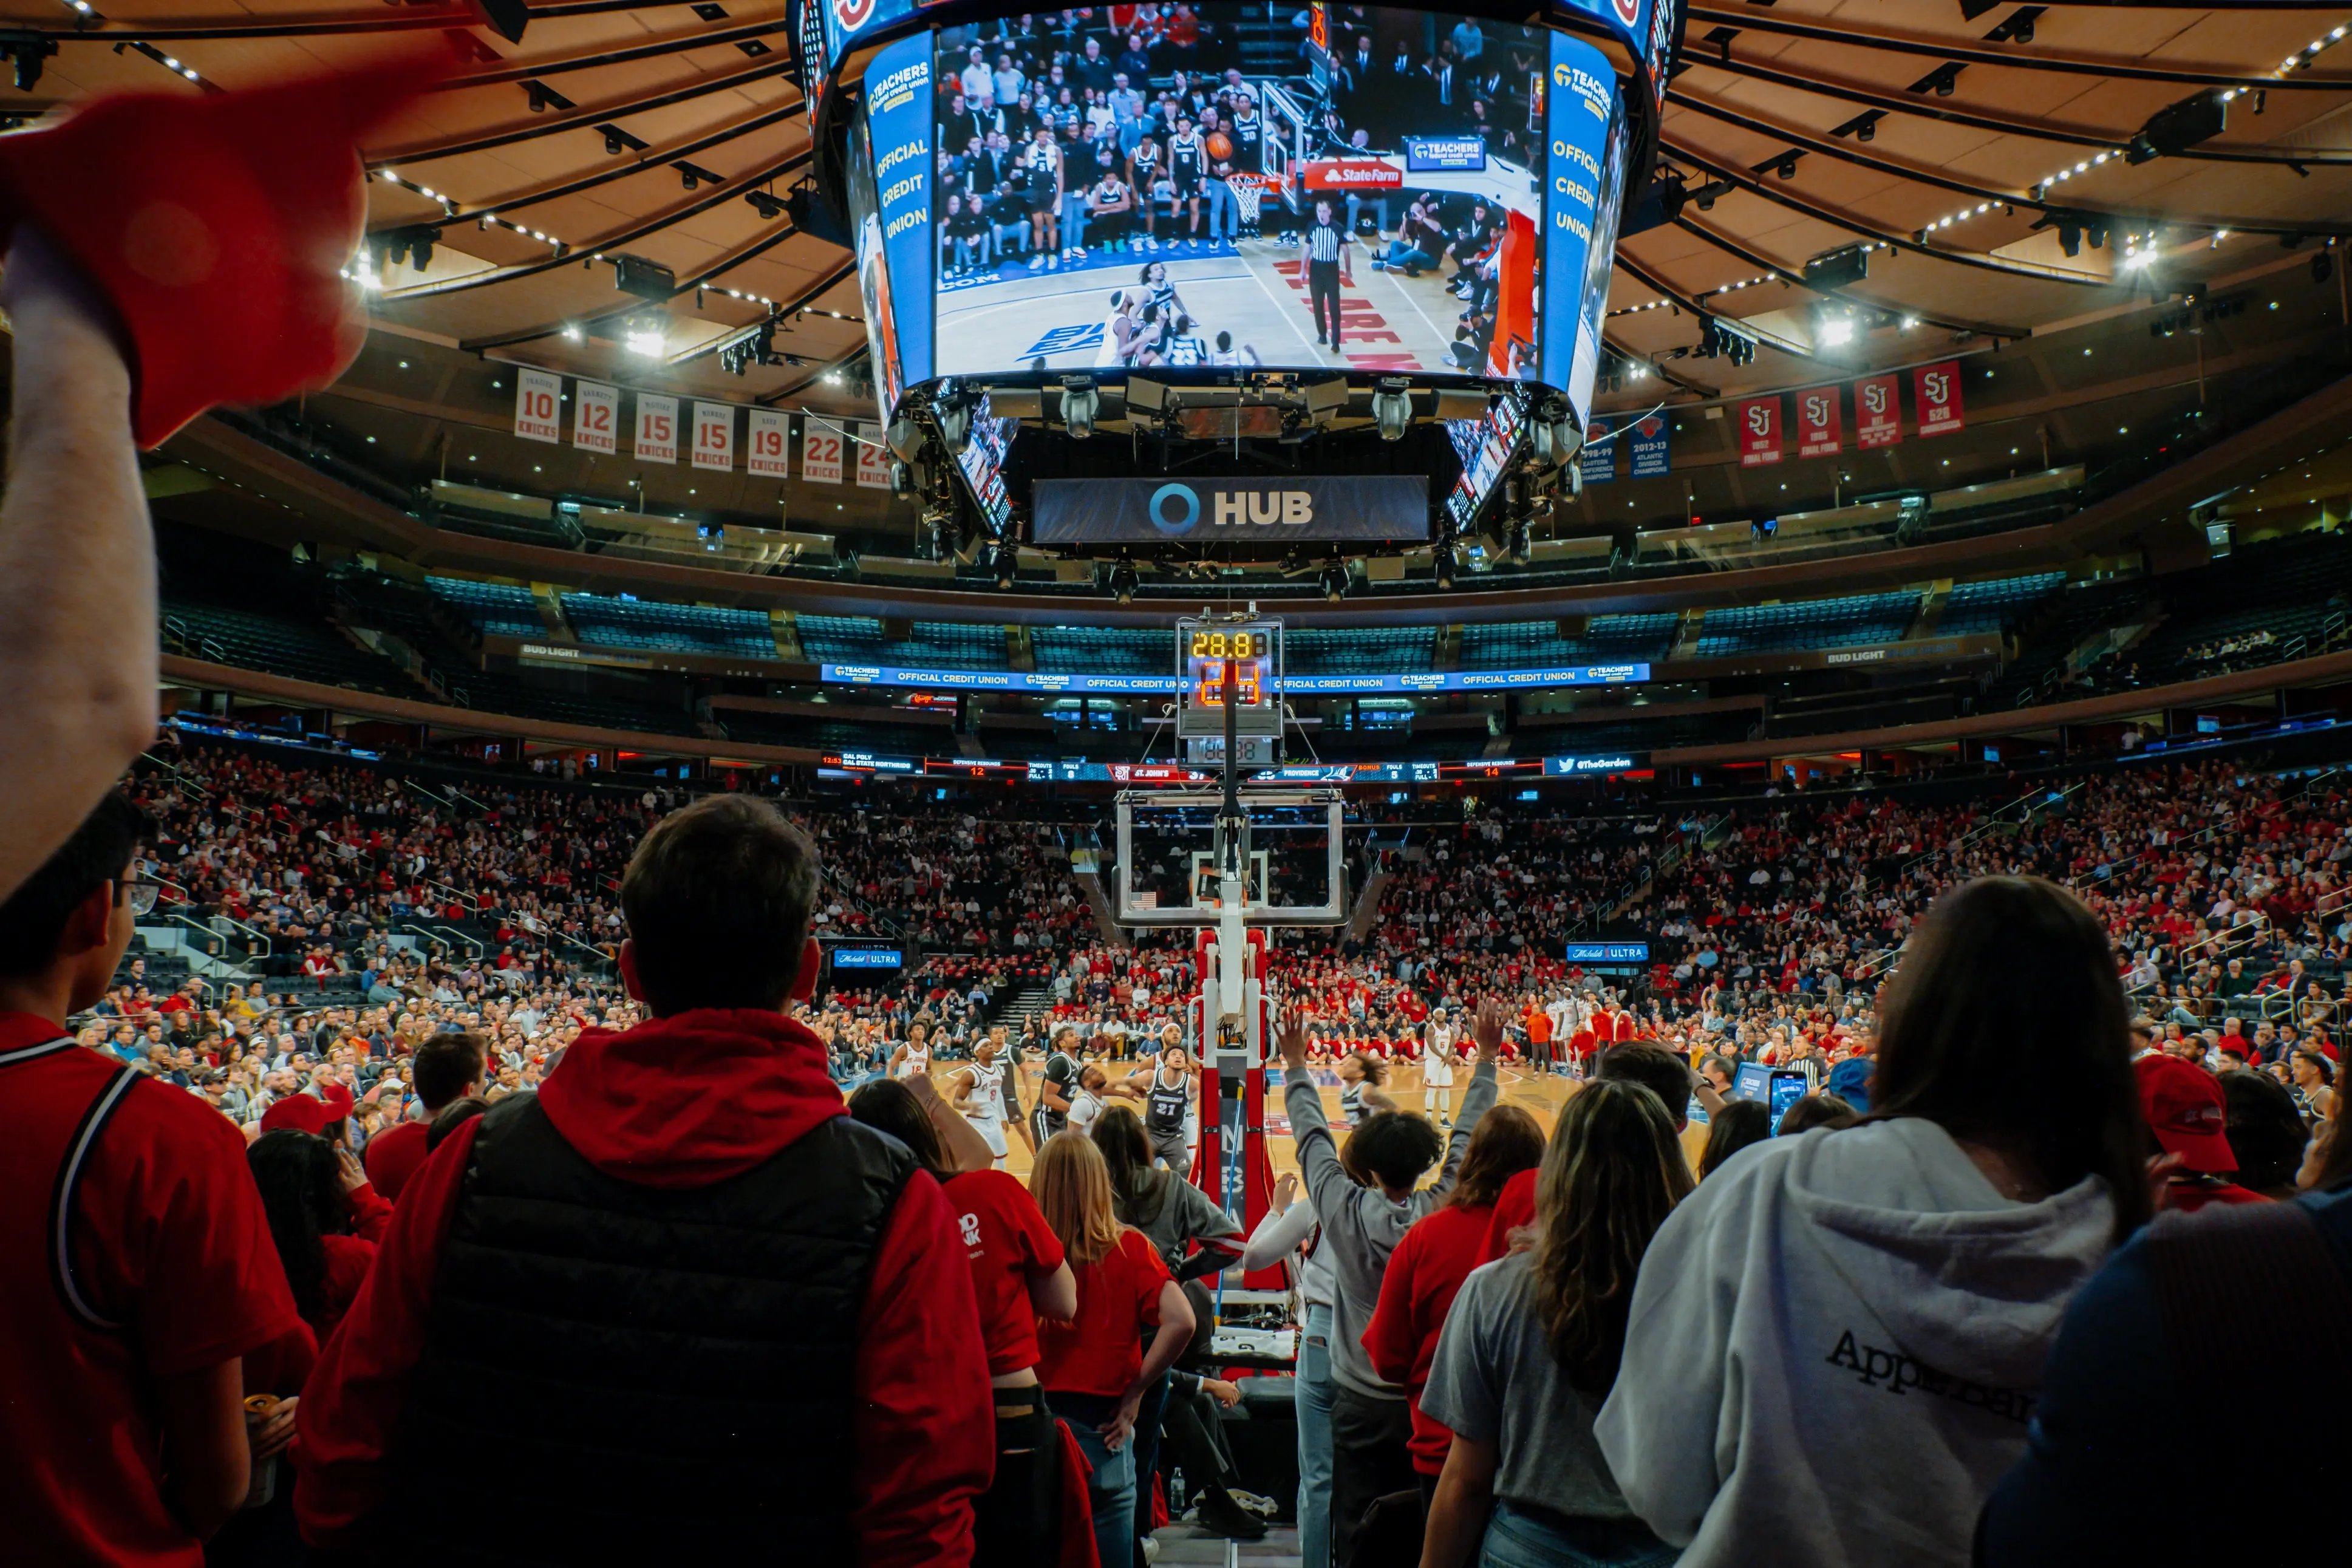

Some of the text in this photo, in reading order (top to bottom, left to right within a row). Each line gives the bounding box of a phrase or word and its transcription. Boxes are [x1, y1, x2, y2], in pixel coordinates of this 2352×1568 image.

[874, 62, 928, 100] TEACHERS
[890, 83, 908, 97] credit
[909, 77, 929, 89] union
[1572, 68, 1611, 110] TEACHERS
[1572, 82, 1592, 99] federal
[1243, 131, 1256, 141] 30
[1427, 143, 1479, 152] TEACHERS
[878, 139, 928, 178] OFFICIAL
[1553, 140, 1600, 182] OFFICIAL
[882, 174, 923, 208] CREDIT
[1556, 177, 1595, 211] CREDIT
[887, 207, 927, 239] UNION
[1556, 211, 1590, 244] UNION
[525, 390, 553, 420] 10
[583, 403, 610, 431] 12
[519, 420, 556, 437] KNICKS
[643, 414, 670, 441] 15
[577, 432, 613, 449] KNICKS
[700, 423, 726, 449] 15
[638, 443, 674, 458] KNICKS
[756, 431, 782, 456] 19
[807, 437, 839, 463] 22
[1634, 441, 1666, 452] 2012-13
[695, 452, 731, 466] KNICKS
[1584, 448, 1612, 458] 998-99
[751, 459, 785, 473] KNICKS
[805, 466, 840, 479] KNICKS
[1634, 466, 1667, 475] CHAMPIONS
[1215, 491, 1312, 525] HUB
[523, 644, 547, 655] BUD
[547, 647, 579, 658] LIGHT
[1827, 653, 1851, 663] BUD
[1852, 650, 1885, 661] LIGHT
[898, 672, 1008, 684] OFFICIAL CREDIT UNION
[1087, 679, 1128, 688] OFFICIAL
[1131, 680, 1164, 688] CREDIT
[1353, 679, 1383, 687] UNION
[1463, 672, 1575, 684] OFFICIAL CREDIT UNION
[1577, 758, 1631, 769] @TheGarden
[971, 767, 984, 775] 12
[1391, 771, 1398, 779] 5
[1484, 768, 1499, 776] 14
[1573, 949, 1642, 958] Michelob ULTRA
[1156, 1102, 1175, 1116] 21
